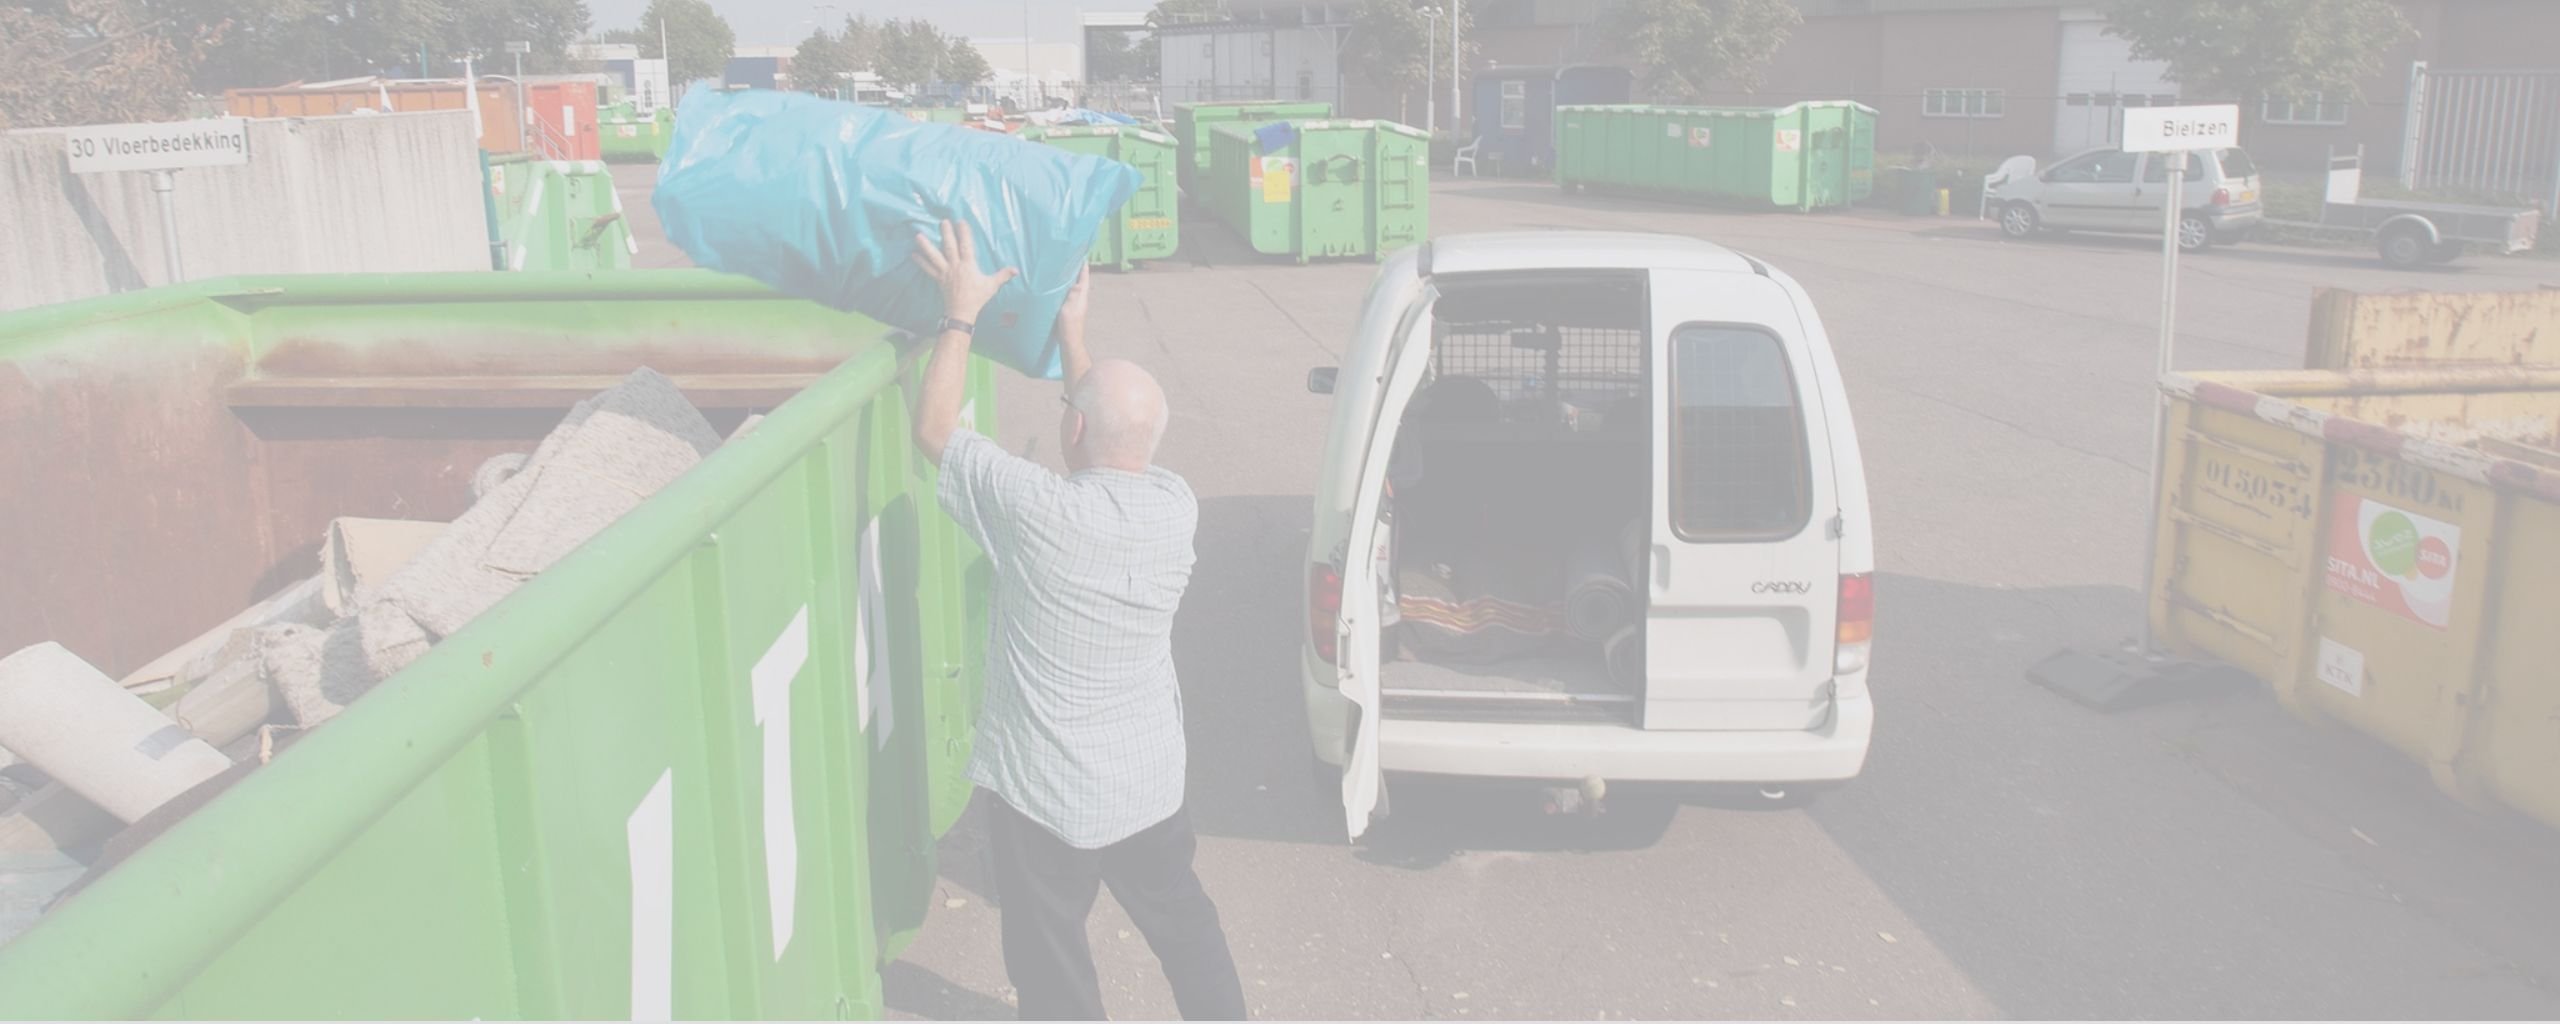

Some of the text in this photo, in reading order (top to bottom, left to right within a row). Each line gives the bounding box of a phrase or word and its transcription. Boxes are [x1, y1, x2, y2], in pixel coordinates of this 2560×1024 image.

[2164, 120, 2228, 137] Bielzen
[71, 130, 241, 158] 30 Vloerbedekking
[2327, 555, 2380, 591] SITA.NL
[1751, 580, 1812, 595] CADDY
